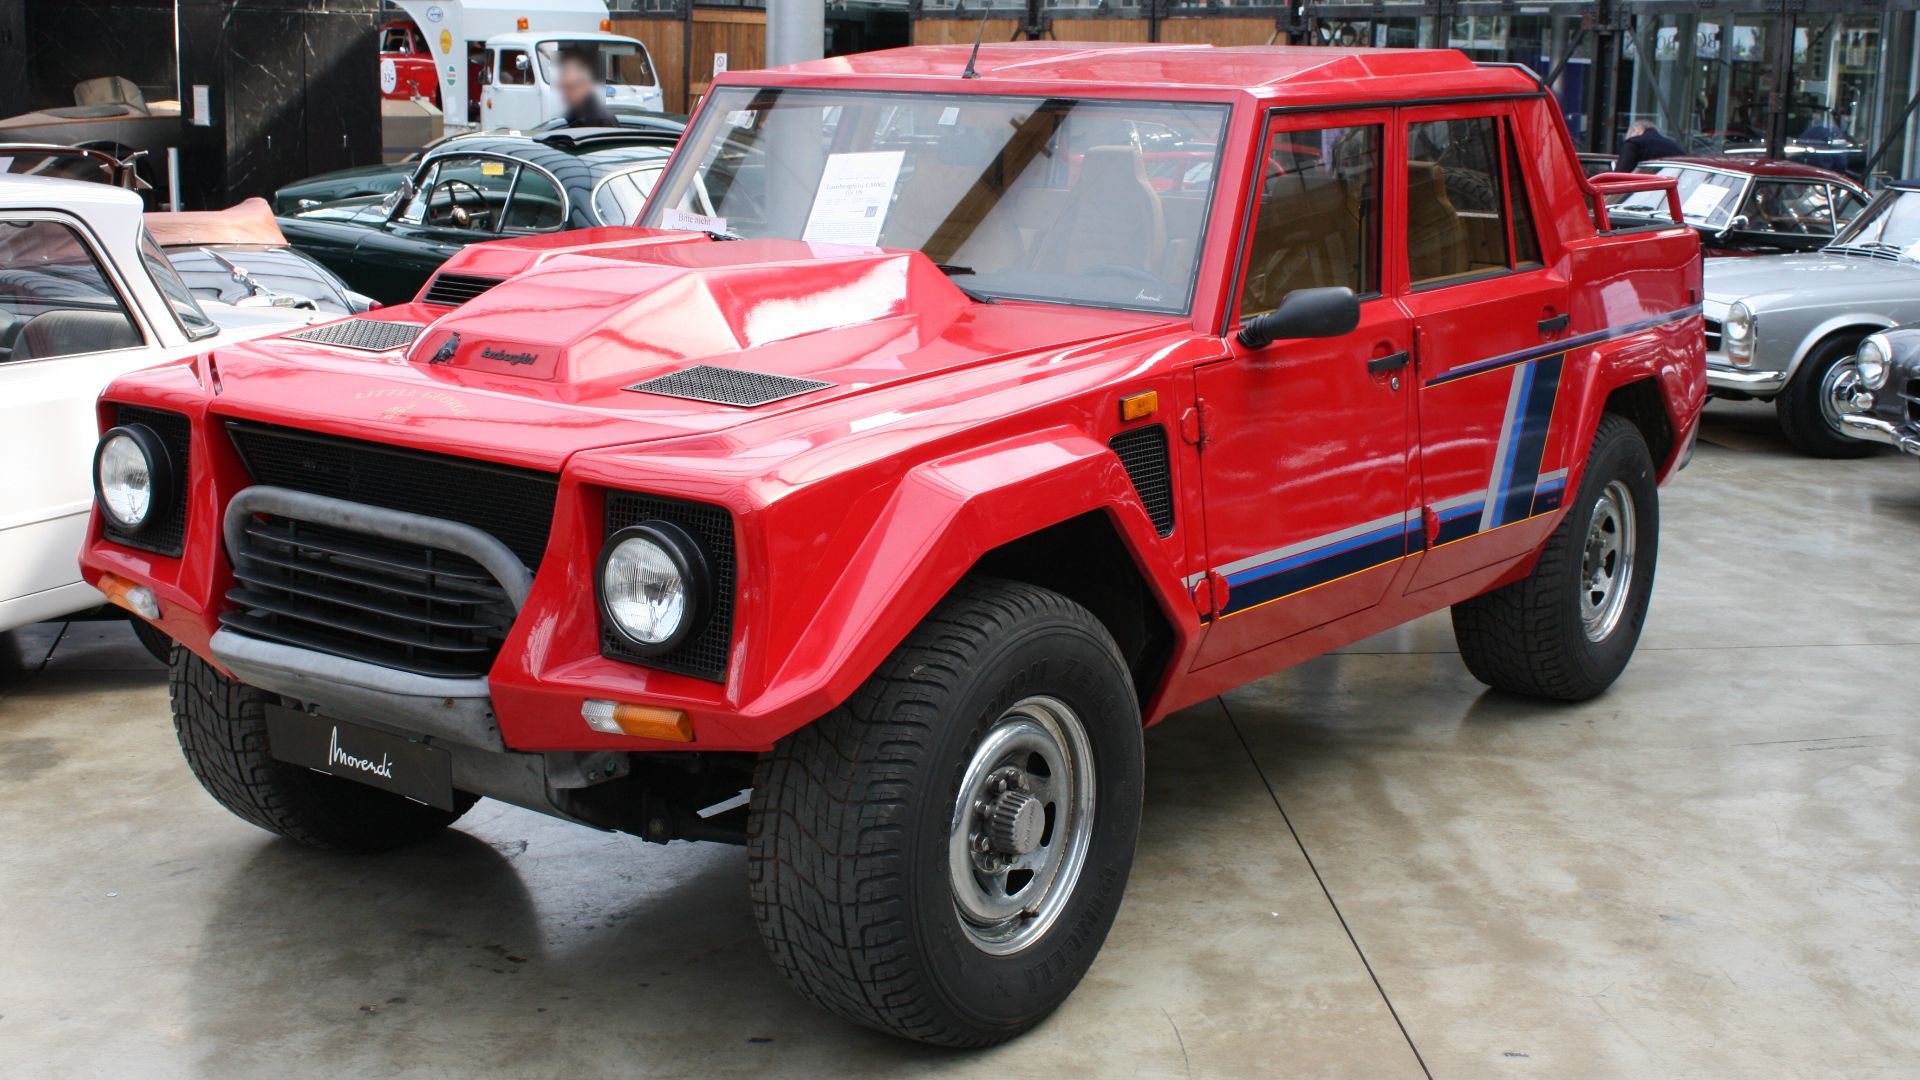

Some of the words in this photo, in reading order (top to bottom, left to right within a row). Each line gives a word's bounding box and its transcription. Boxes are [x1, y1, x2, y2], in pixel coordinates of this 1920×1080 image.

[678, 213, 694, 224] Bitte
[694, 215, 711, 226] nicht
[354, 388, 417, 400] LITTLE
[328, 725, 393, 779] Movendi
[1025, 864, 1119, 994] PIRELLI
